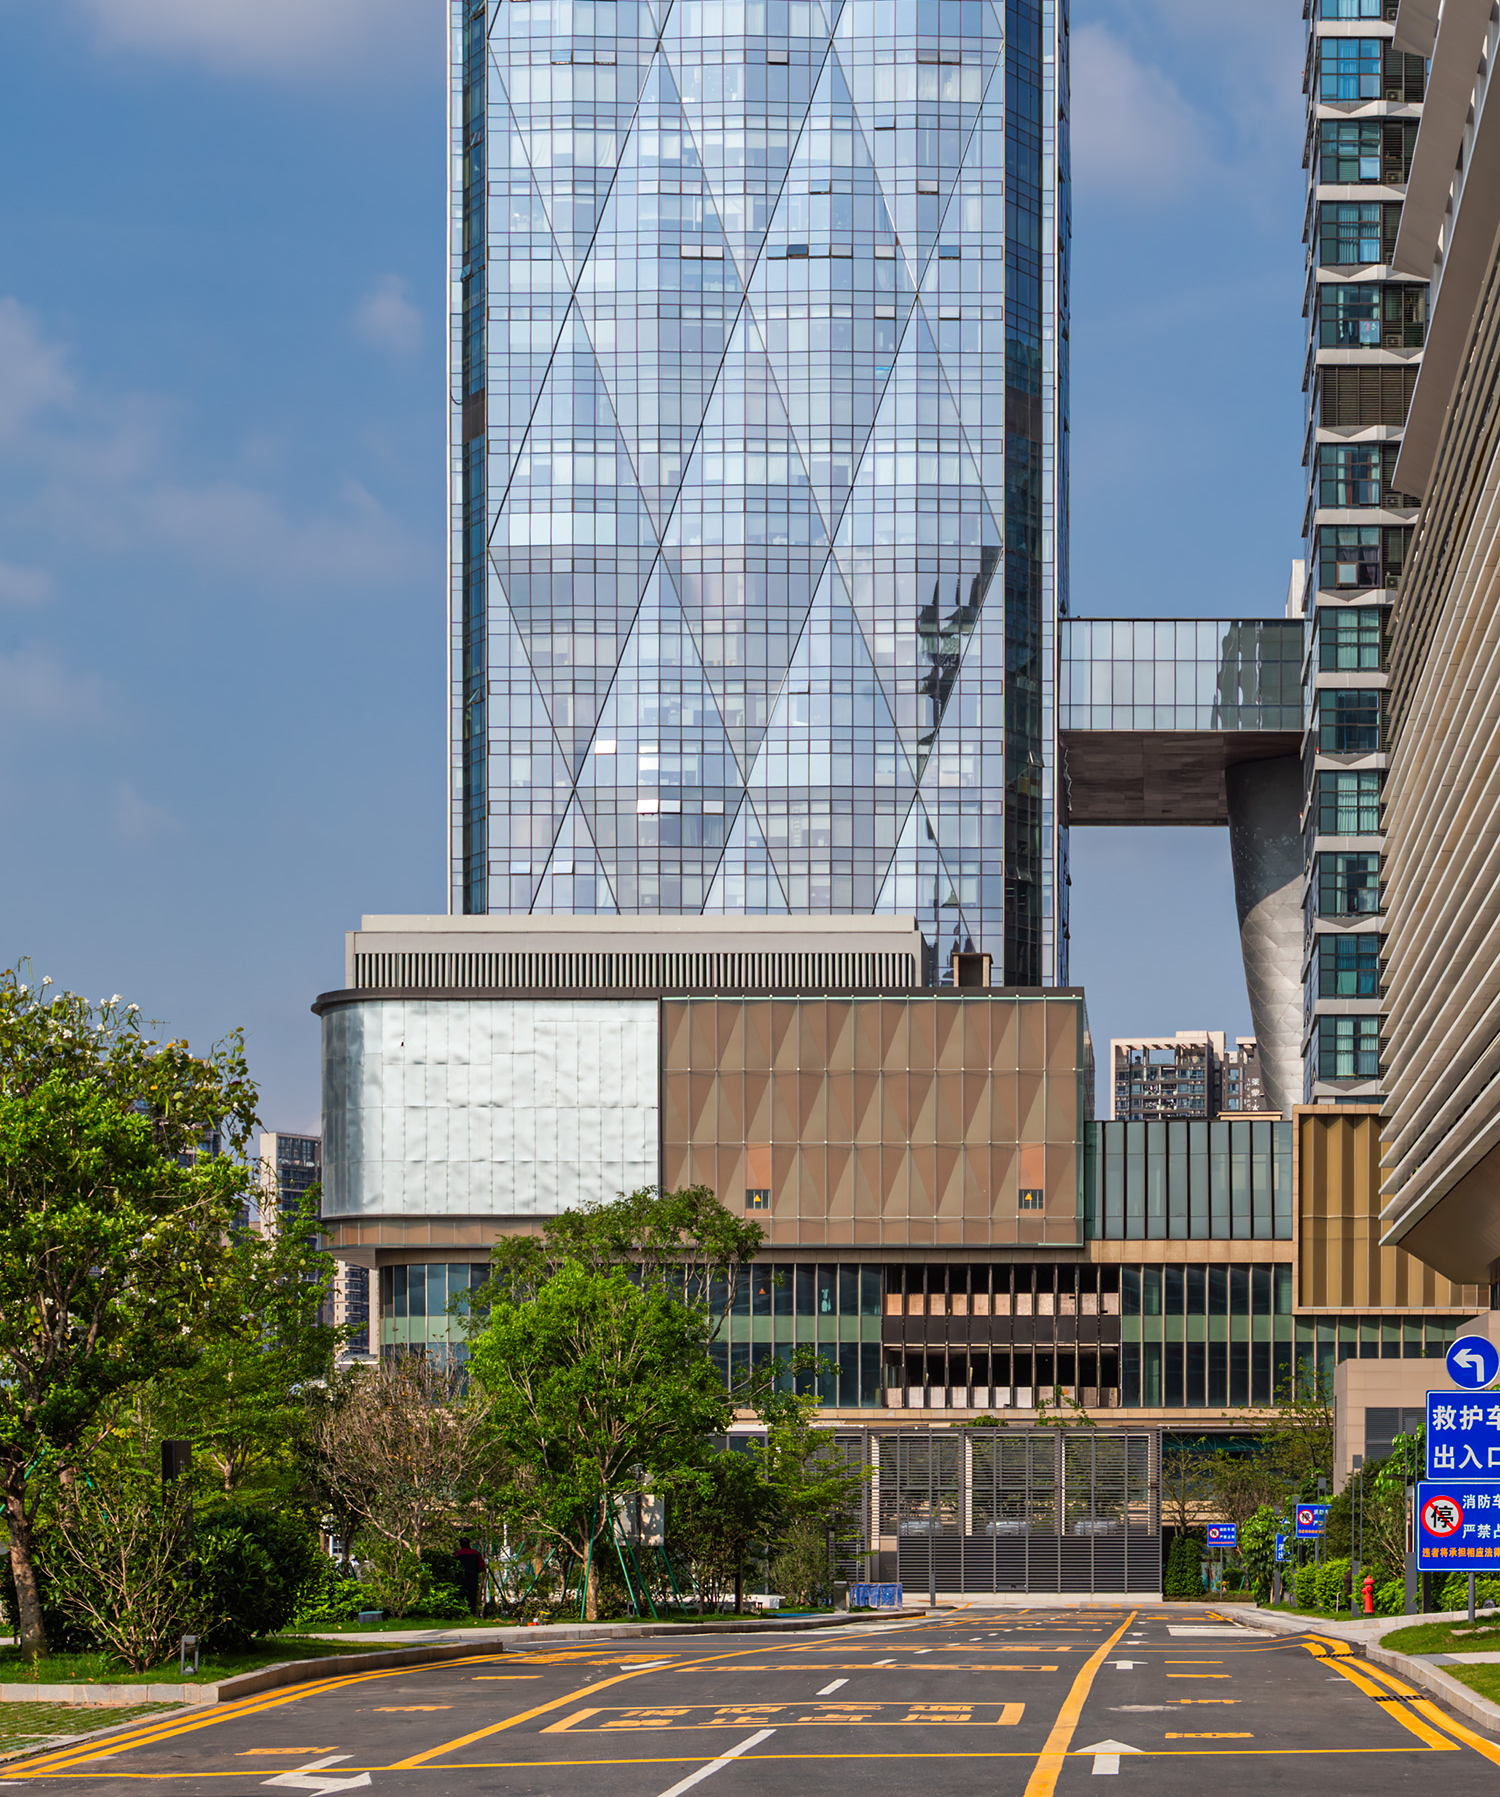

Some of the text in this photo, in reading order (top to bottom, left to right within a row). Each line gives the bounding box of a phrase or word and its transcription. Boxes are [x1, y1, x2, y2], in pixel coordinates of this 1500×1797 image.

[1433, 1444, 1500, 1470] 出入口
[1430, 1505, 1454, 1529] 停
